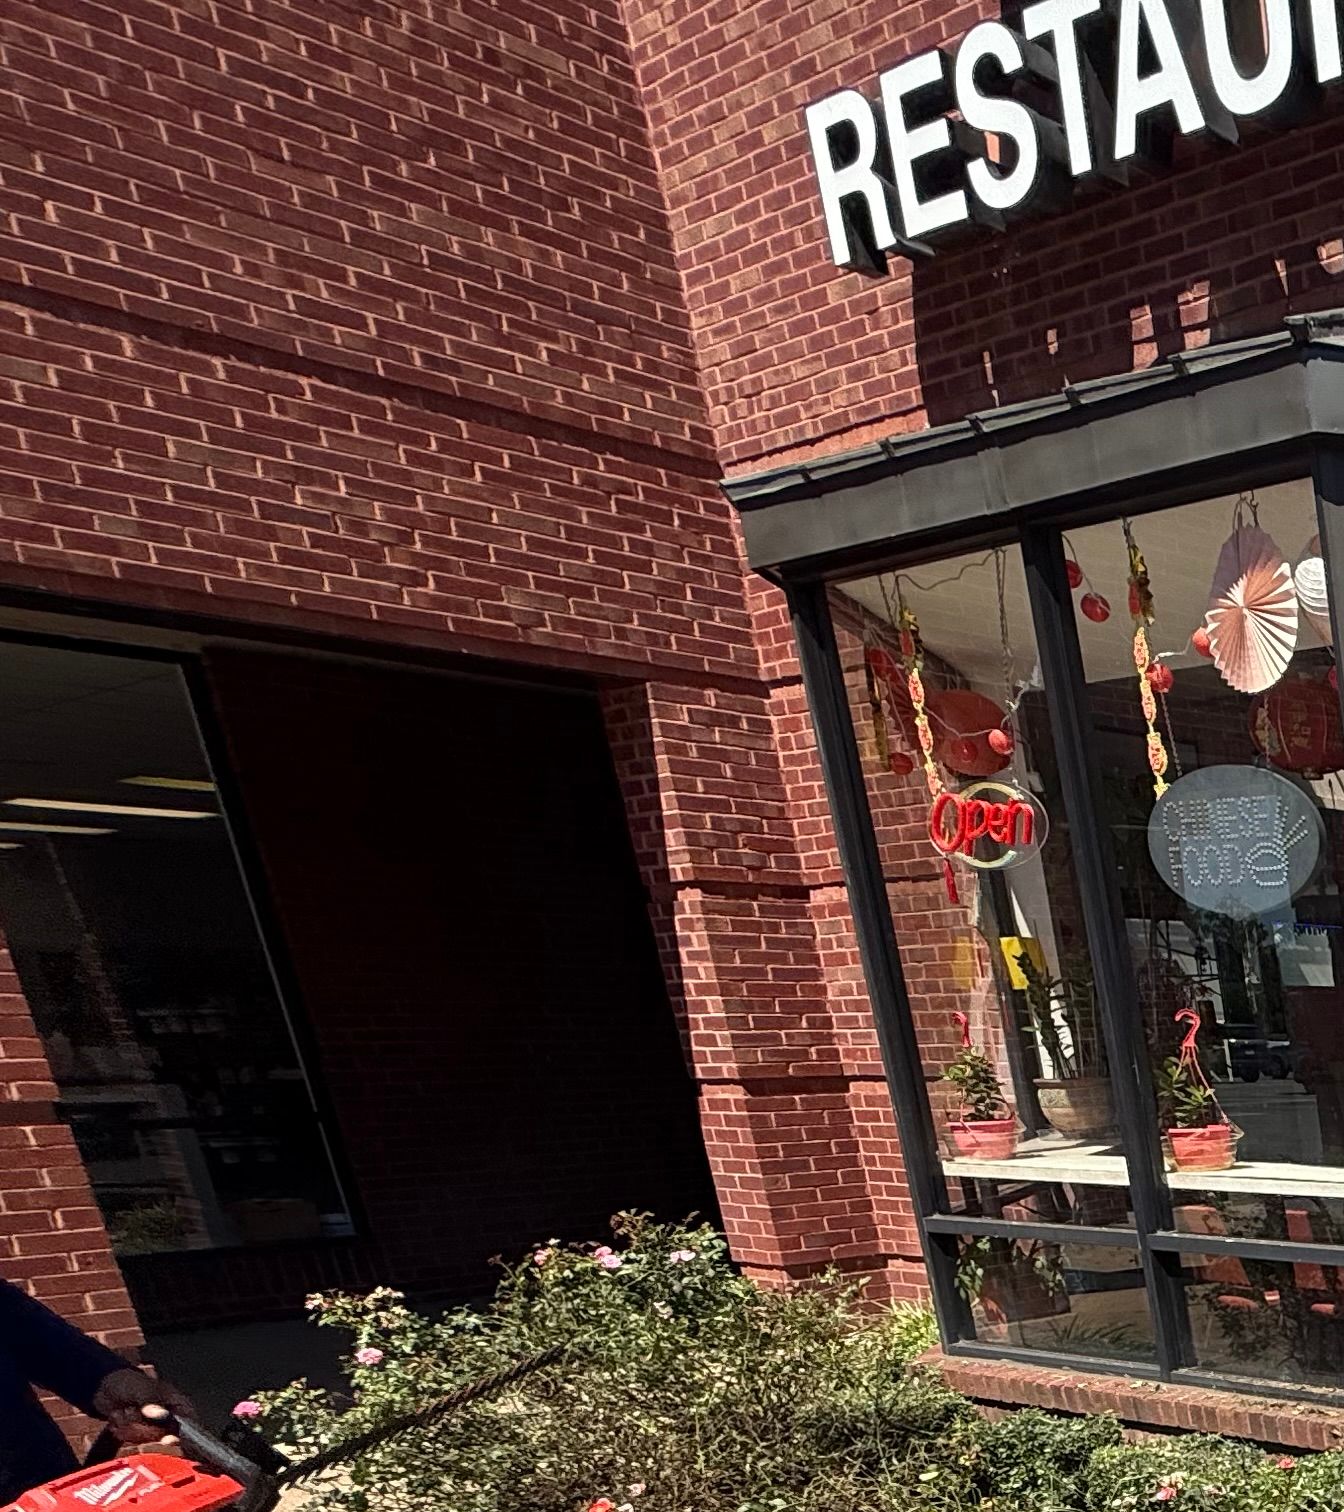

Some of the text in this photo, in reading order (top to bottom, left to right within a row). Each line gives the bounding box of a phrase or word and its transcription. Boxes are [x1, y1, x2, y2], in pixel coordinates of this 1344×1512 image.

[932, 793, 1034, 857] Open
[1162, 796, 1270, 841] CHINESE
[1168, 844, 1246, 888] FOOD
